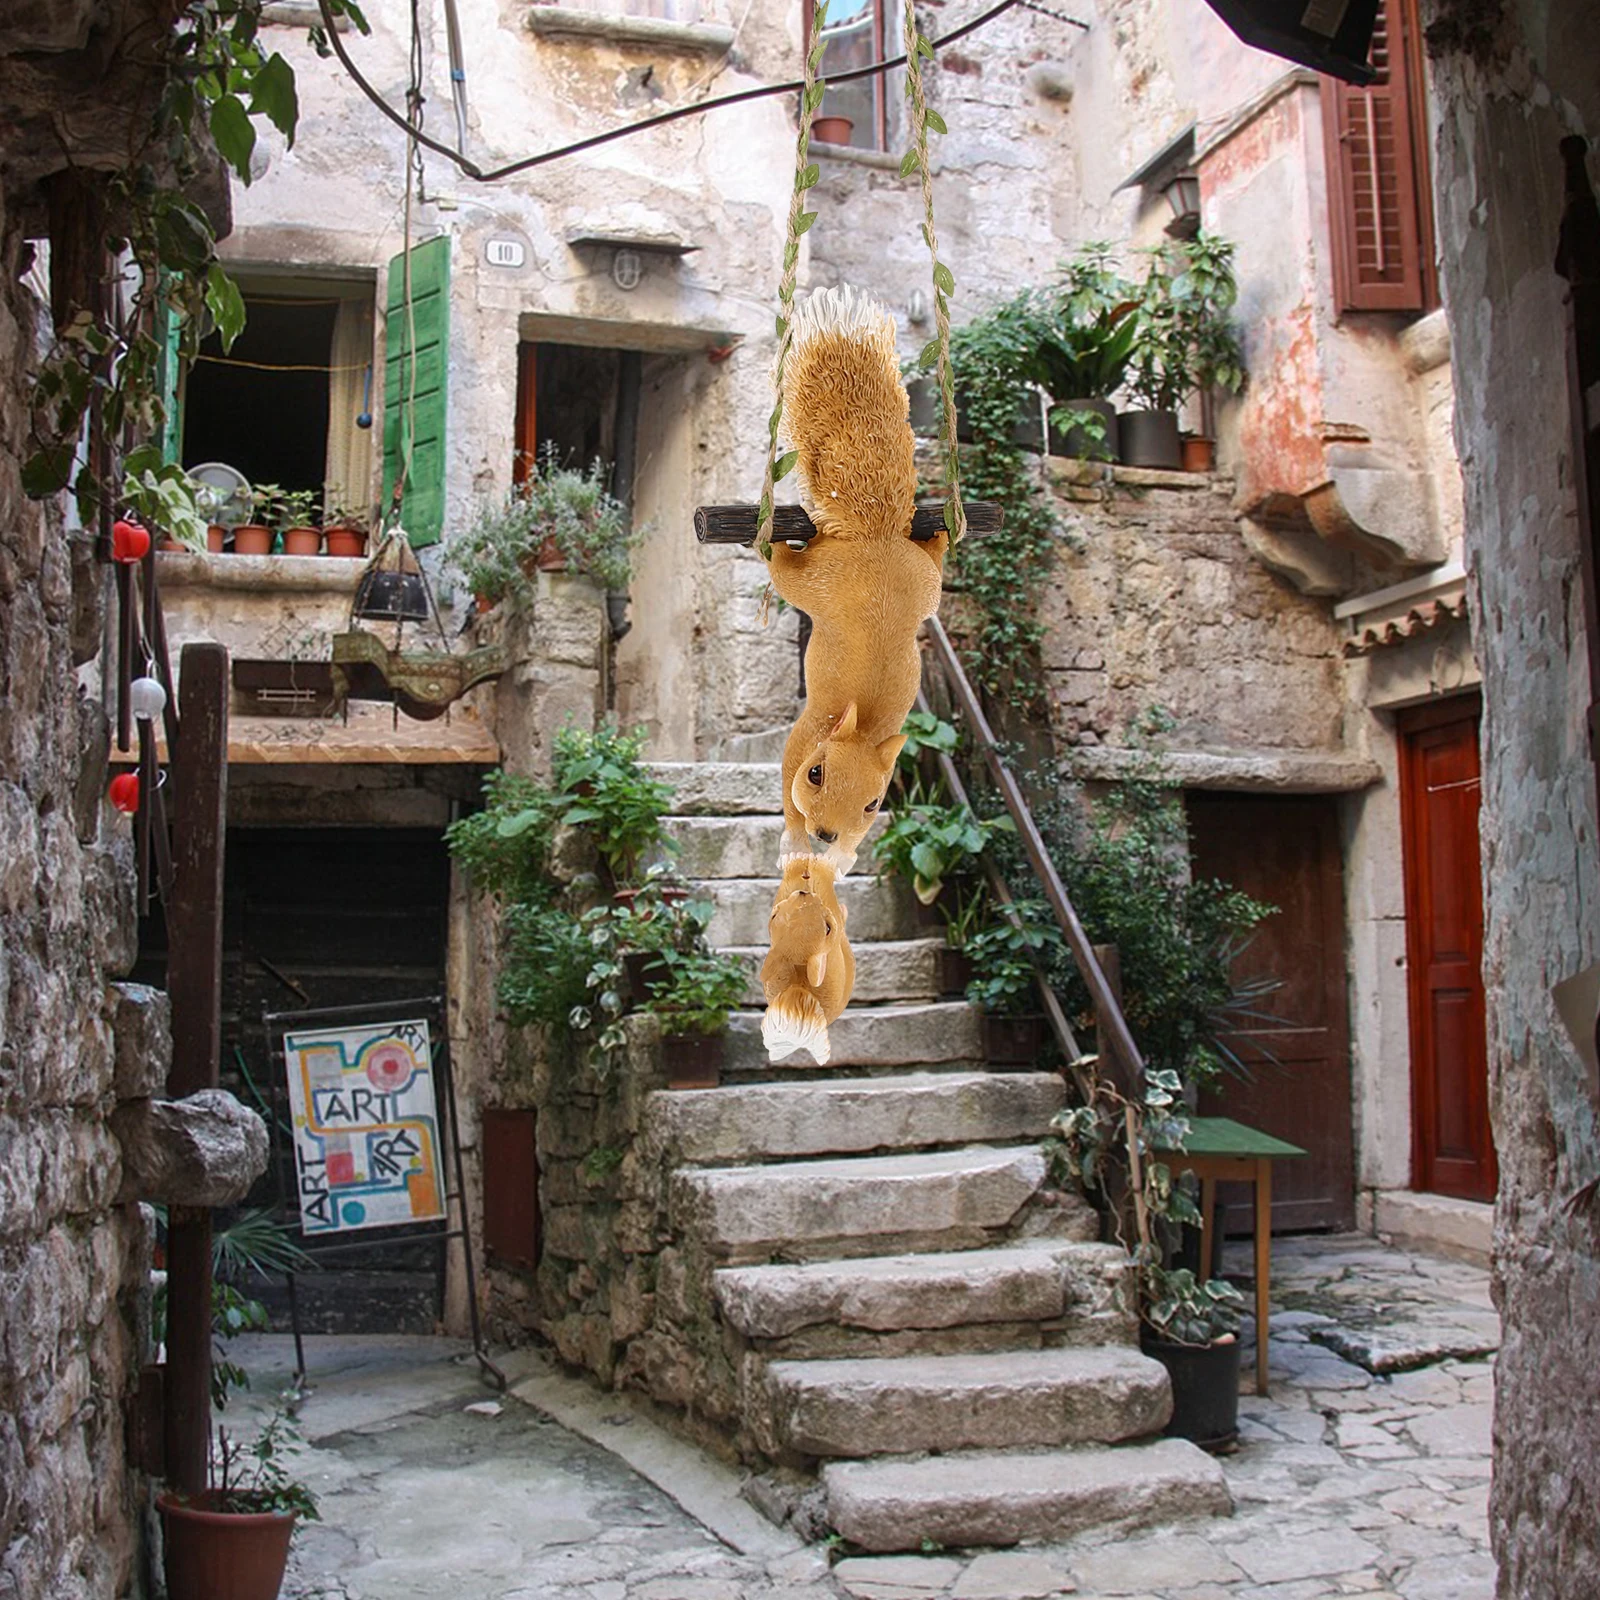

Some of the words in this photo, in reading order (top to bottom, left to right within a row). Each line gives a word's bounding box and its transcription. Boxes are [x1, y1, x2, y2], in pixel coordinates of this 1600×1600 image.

[498, 244, 513, 261] 10
[389, 1024, 426, 1052] ART
[324, 1088, 390, 1124] ART
[371, 1129, 420, 1177] ART
[297, 1144, 331, 1224] ART
